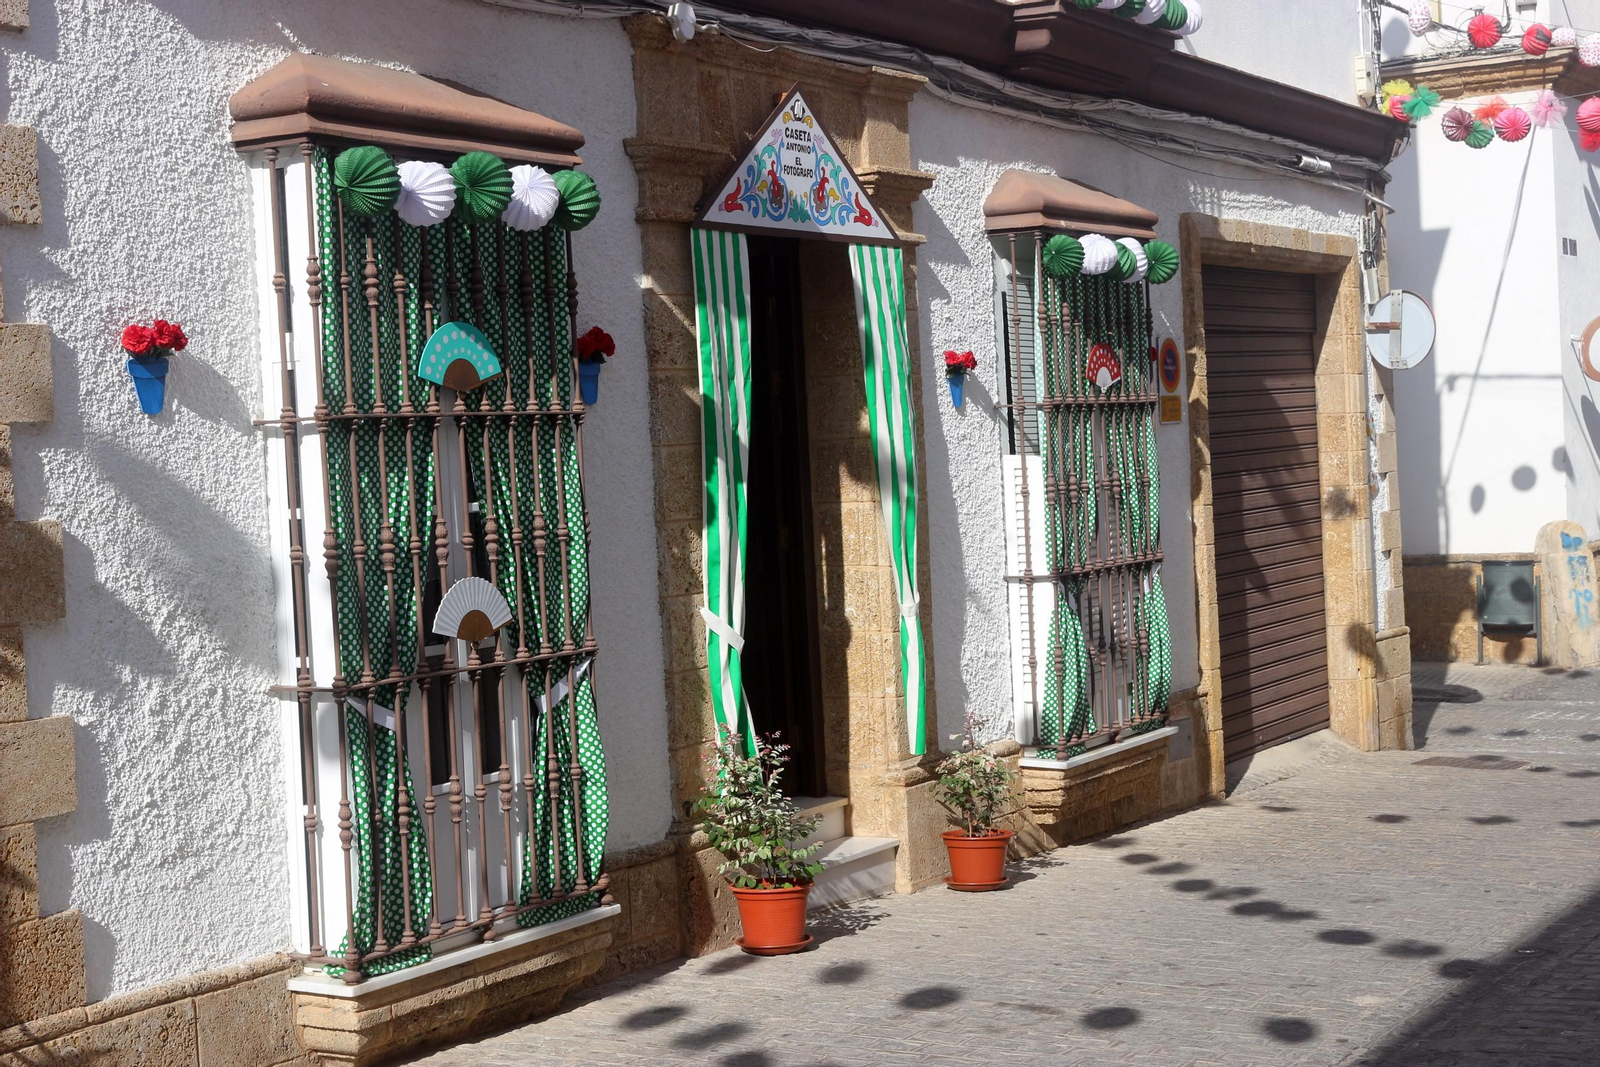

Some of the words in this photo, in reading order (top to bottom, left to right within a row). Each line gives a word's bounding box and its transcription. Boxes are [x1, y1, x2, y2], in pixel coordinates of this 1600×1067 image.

[785, 127, 811, 142] CASETA
[786, 142, 811, 154] ANTONIO
[795, 157, 802, 166] EL
[784, 165, 813, 178] FOTOGRAFO
